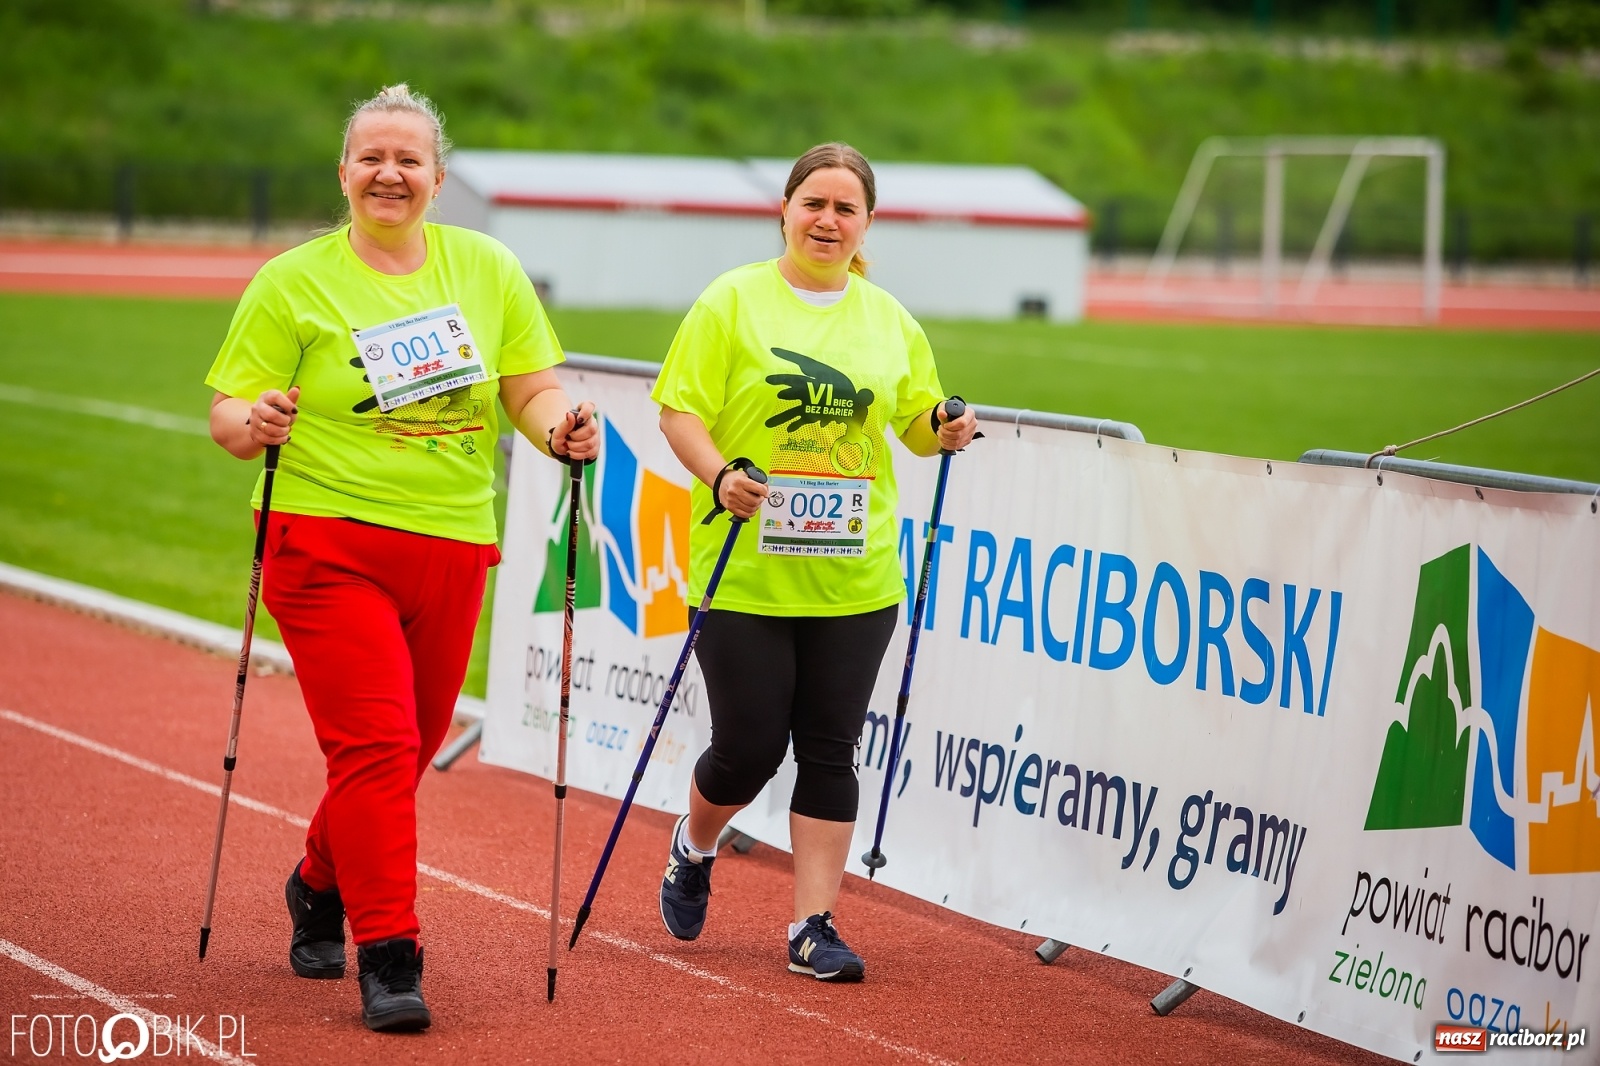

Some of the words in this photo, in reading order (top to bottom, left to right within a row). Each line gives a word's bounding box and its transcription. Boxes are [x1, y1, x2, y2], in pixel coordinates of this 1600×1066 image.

[391, 331, 449, 367] 001
[805, 406, 821, 414] BEZ
[823, 407, 854, 417] BARIER
[807, 382, 833, 406] VI
[833, 399, 853, 408] BIEG
[790, 492, 843, 519] 002
[852, 493, 863, 507] R
[960, 529, 1343, 718] RACIBORSKI
[524, 644, 595, 692] powat
[934, 724, 1160, 873] wspieramy,
[1167, 790, 1307, 916] gramy
[1341, 867, 1451, 945] powiat
[1465, 896, 1590, 983] racibor
[798, 937, 817, 962] N
[1328, 943, 1428, 1010] zielona
[1446, 987, 1521, 1034] oaza
